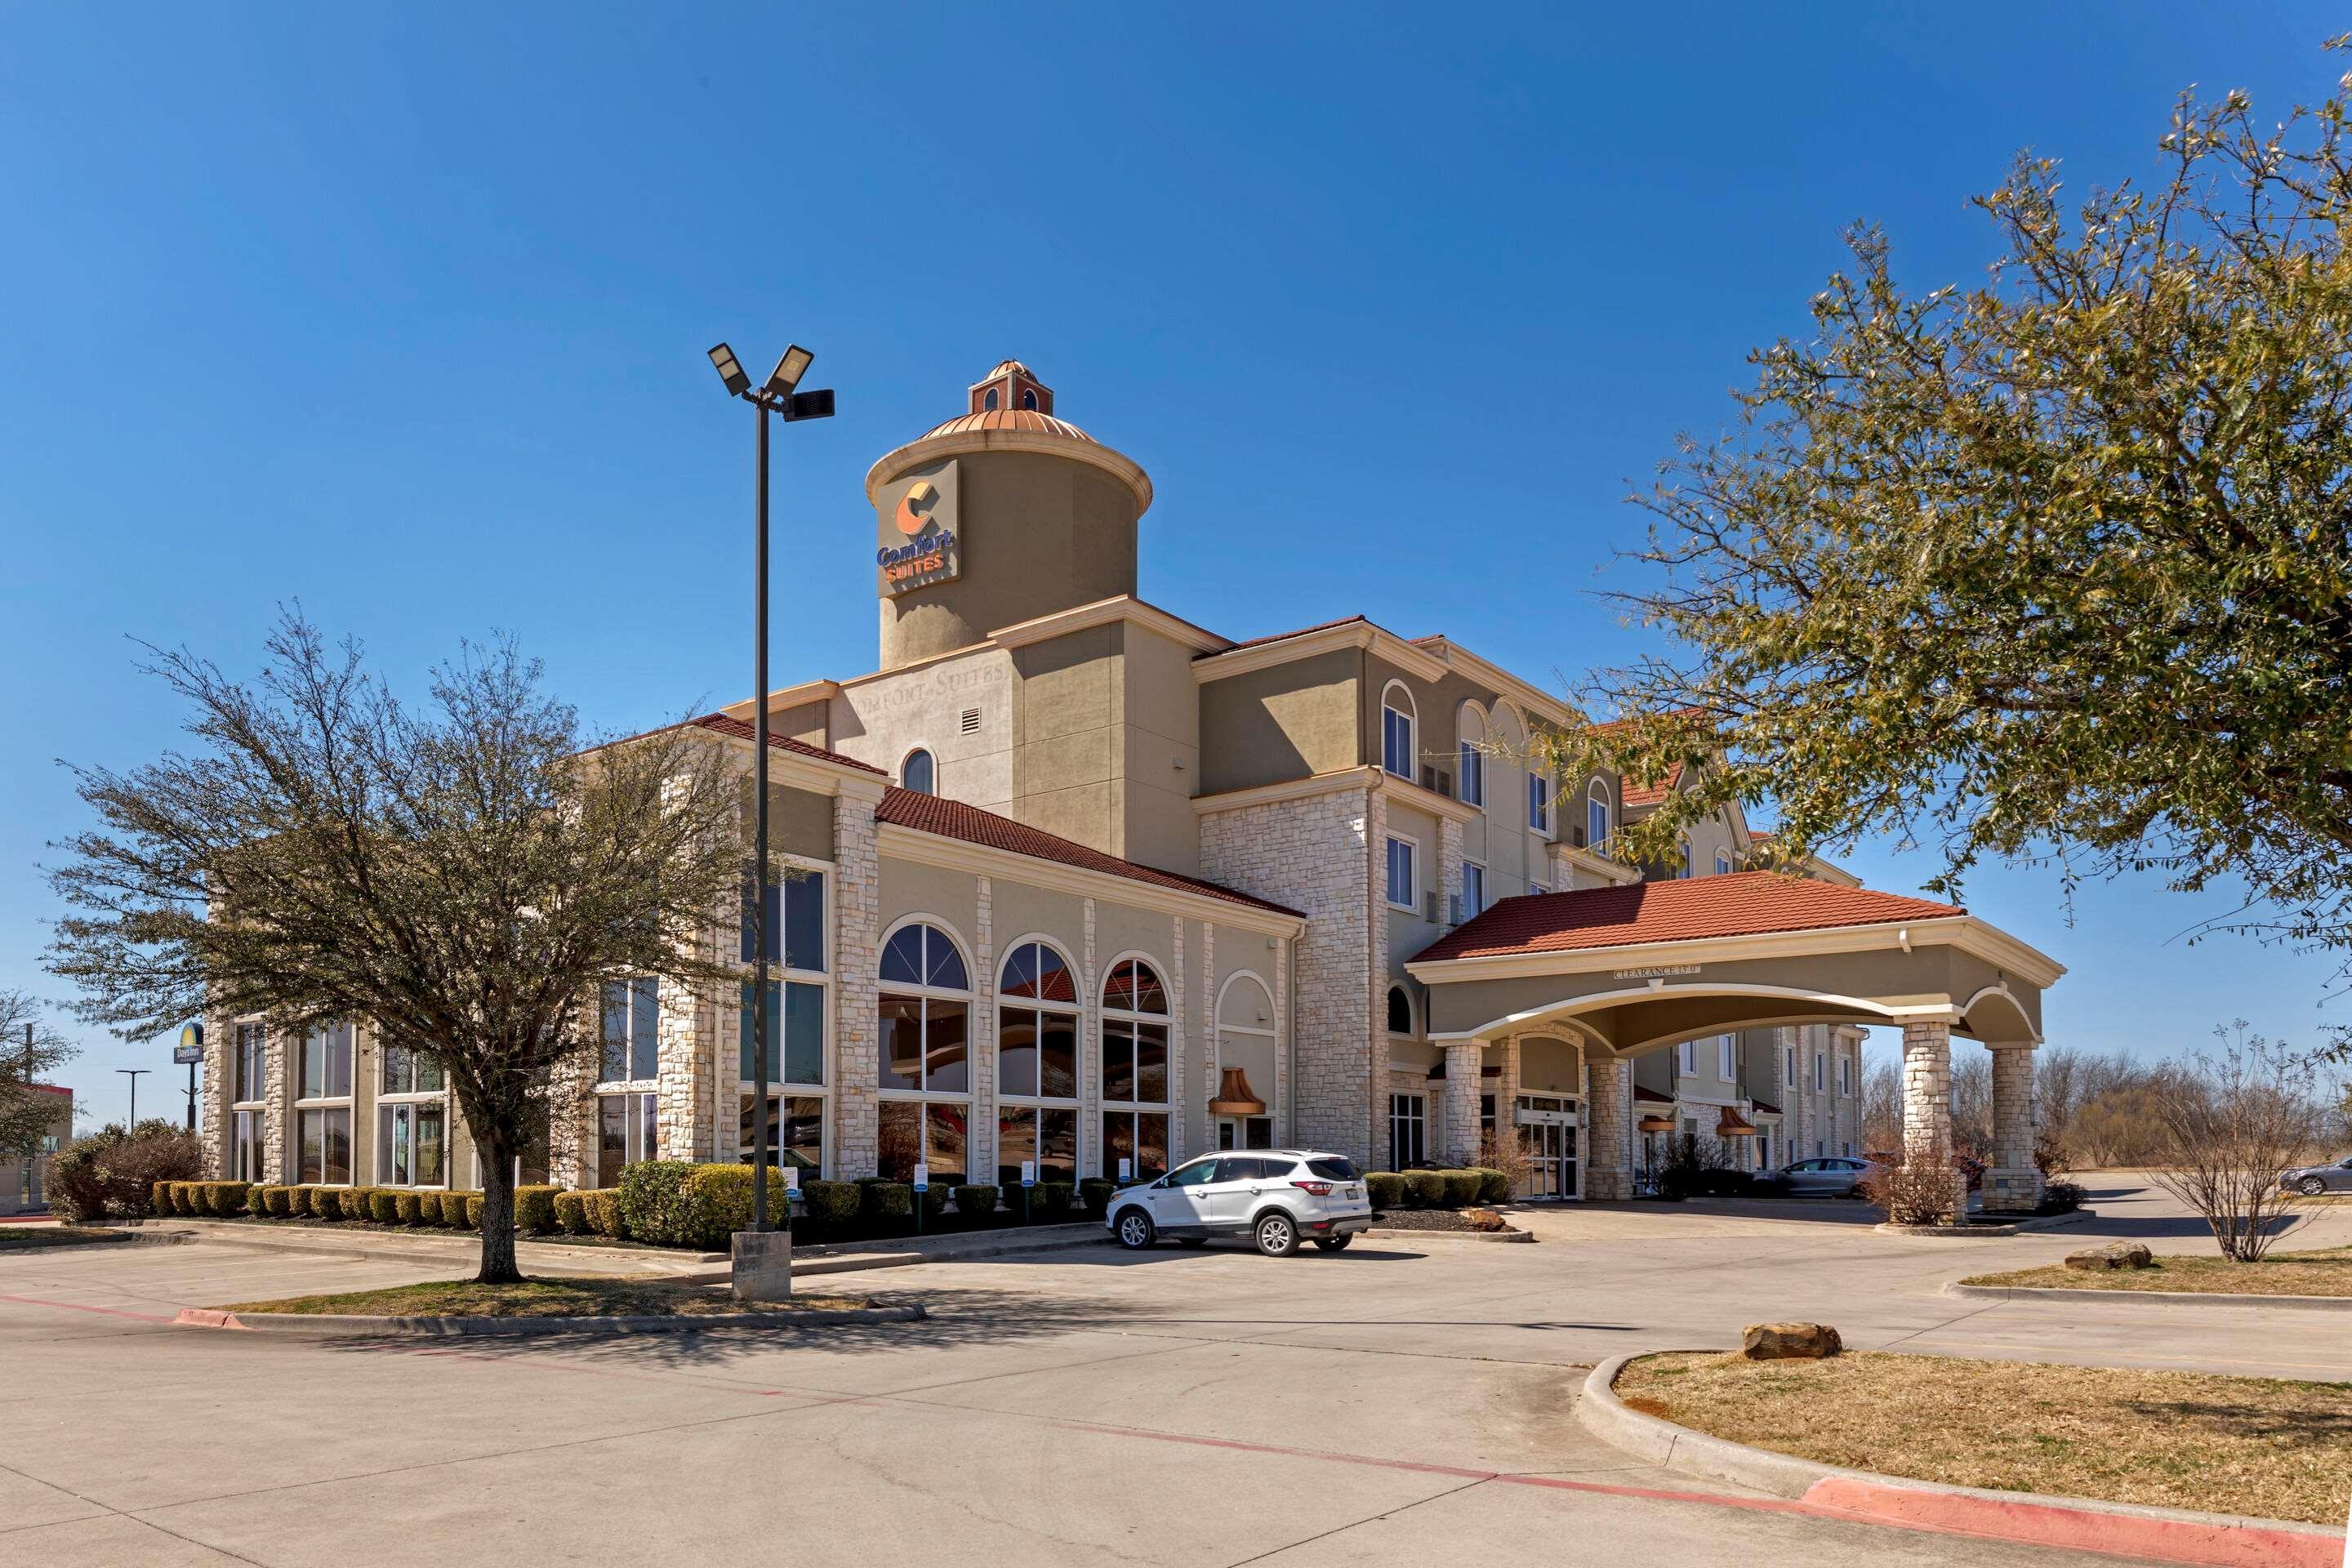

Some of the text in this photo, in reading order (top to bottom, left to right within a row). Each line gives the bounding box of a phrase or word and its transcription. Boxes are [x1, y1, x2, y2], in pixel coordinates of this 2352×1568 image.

[876, 529, 952, 566] Comfort
[885, 555, 942, 583] SUITES
[1615, 966, 1675, 979] CLEARANCE
[177, 1049, 189, 1058] Days
